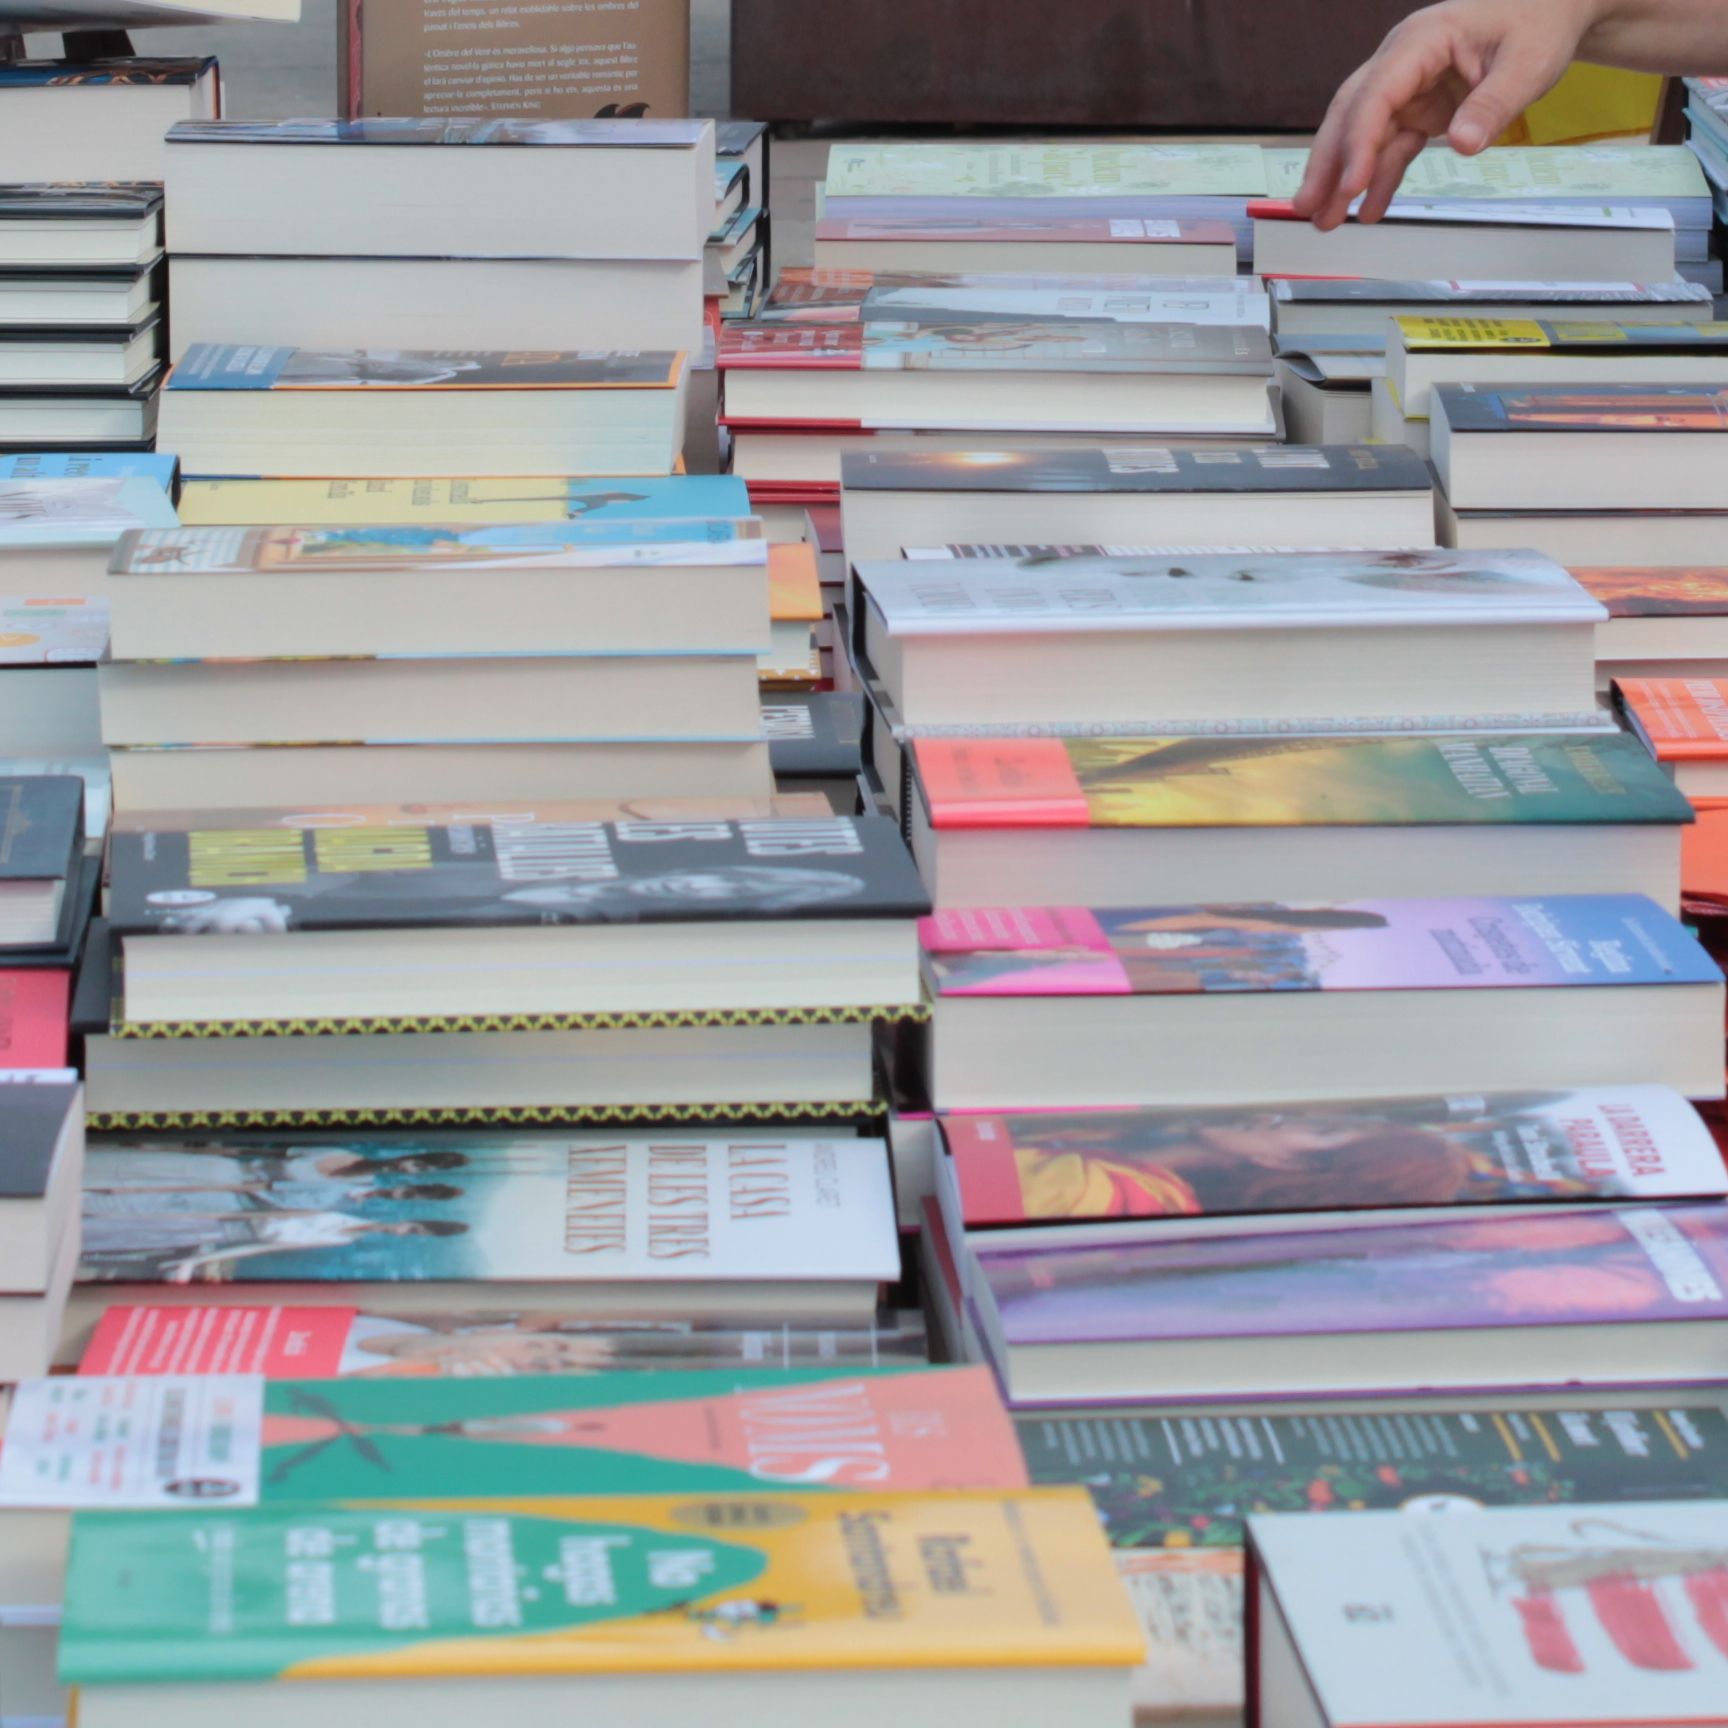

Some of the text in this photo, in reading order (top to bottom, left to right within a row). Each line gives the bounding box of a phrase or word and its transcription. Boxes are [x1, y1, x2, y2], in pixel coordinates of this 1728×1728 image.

[1486, 746, 1560, 795] DIAGONAL
[727, 1143, 793, 1221] LA CASA
[1605, 1115, 1668, 1178] DARRERA
[564, 1143, 629, 1255] XEMENEIES
[645, 1143, 711, 1261] DE LES TRES
[733, 1382, 890, 1484] NOMS
